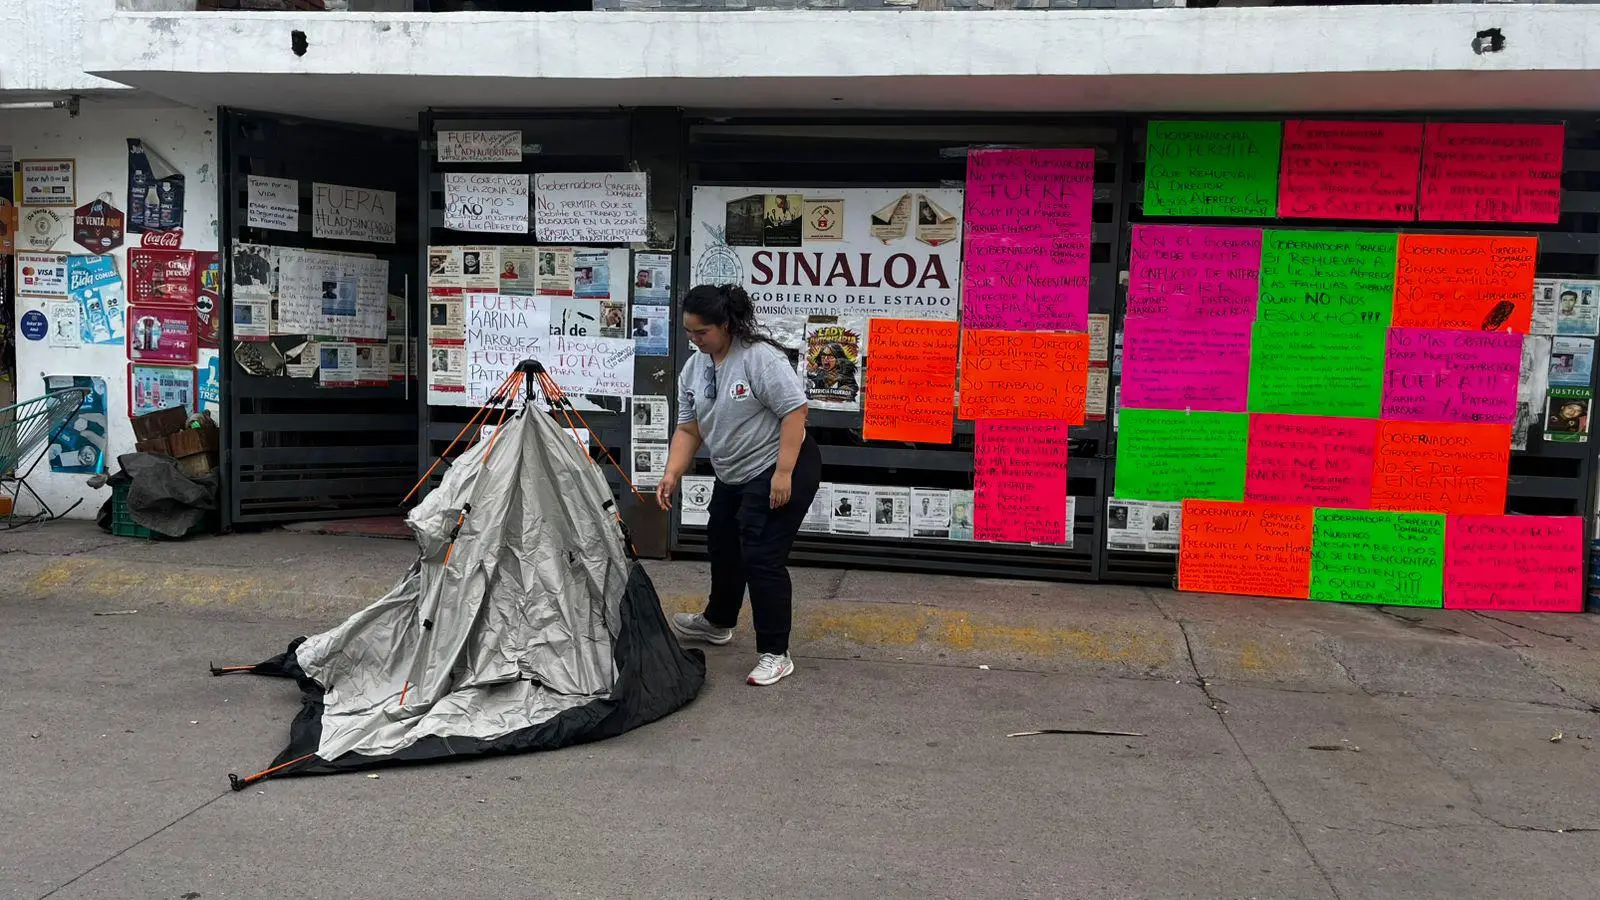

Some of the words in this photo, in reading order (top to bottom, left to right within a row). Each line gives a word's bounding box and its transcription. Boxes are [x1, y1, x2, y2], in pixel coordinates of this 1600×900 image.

[448, 132, 487, 143] FUERA
[1149, 143, 1180, 159] NO
[446, 174, 466, 184] LOS
[1169, 179, 1224, 190] DIRECTOR
[448, 184, 461, 192] DE
[467, 185, 480, 193] LA
[481, 185, 508, 194] ZONA
[512, 187, 528, 197] SUR
[980, 183, 1081, 201] FUERA
[316, 184, 385, 216] FUERA
[448, 193, 515, 207] DECIMOS
[560, 200, 597, 209] PERMITA
[601, 200, 620, 209] QUE
[463, 203, 483, 216] NO
[76, 215, 84, 225] DE
[85, 216, 104, 226] VENTA
[484, 220, 524, 232] ALFREDO
[538, 218, 580, 226] BUSQUEDA
[600, 218, 611, 226] LA
[571, 228, 584, 237] DE
[1404, 236, 1487, 255] GOBERNADORA
[1288, 252, 1364, 265] REMUEVEN
[1374, 256, 1386, 267] A
[751, 251, 951, 289] SINALOA
[1456, 267, 1480, 275] DEL
[1485, 267, 1517, 279] LADO
[1000, 274, 1021, 288] NO
[1289, 279, 1347, 289] FAMILIAS
[1418, 277, 1440, 285] LAS
[1447, 276, 1508, 286] FAMILIAS
[751, 292, 838, 304] GOBIERNO
[845, 294, 876, 305] DEL
[884, 295, 951, 307] ESTADO
[1305, 292, 1330, 305] NO
[1340, 295, 1366, 305] NOS
[1396, 287, 1423, 302] NO
[470, 296, 536, 311] FUERA
[794, 306, 827, 316] ESTATAL
[471, 310, 528, 330] KARINA
[569, 324, 587, 337] de
[818, 327, 844, 336] LADY
[871, 320, 893, 334] LOS
[897, 320, 952, 336] COLECTIVOS
[469, 329, 539, 347] MARQUEZ
[558, 336, 608, 354] APOYO
[968, 330, 1023, 347] NUESTRO
[1031, 335, 1084, 349] DIRECTOR
[554, 354, 614, 369] TOTAL
[966, 357, 992, 370] NO
[998, 359, 1048, 371] ESTA
[1055, 359, 1086, 372] SOLO
[549, 366, 576, 376] PARA
[961, 376, 983, 391] SU
[988, 380, 1045, 391] TRABAJO
[1550, 388, 1590, 396] JUSTICIA
[961, 392, 1016, 404] COLECTIVOS
[1023, 396, 1056, 404] ZONA
[1063, 396, 1086, 409] SUR
[959, 407, 976, 417] LO
[1382, 421, 1471, 446] GOBERNADORA
[1374, 458, 1397, 474] NO
[1440, 493, 1452, 504] A
[1459, 494, 1484, 505] LAS
[1315, 509, 1391, 524] GOBERNADORA
[1312, 524, 1319, 535] A
[1245, 543, 1253, 551] A
[1312, 539, 1436, 555] DESAPARECIDOS
[1330, 551, 1342, 560] SE
[1371, 554, 1436, 567] ENCUENTRA
[1315, 560, 1421, 581] DESPIDIENDO
[1313, 576, 1321, 585] A
[1329, 577, 1375, 589] QUIEN
